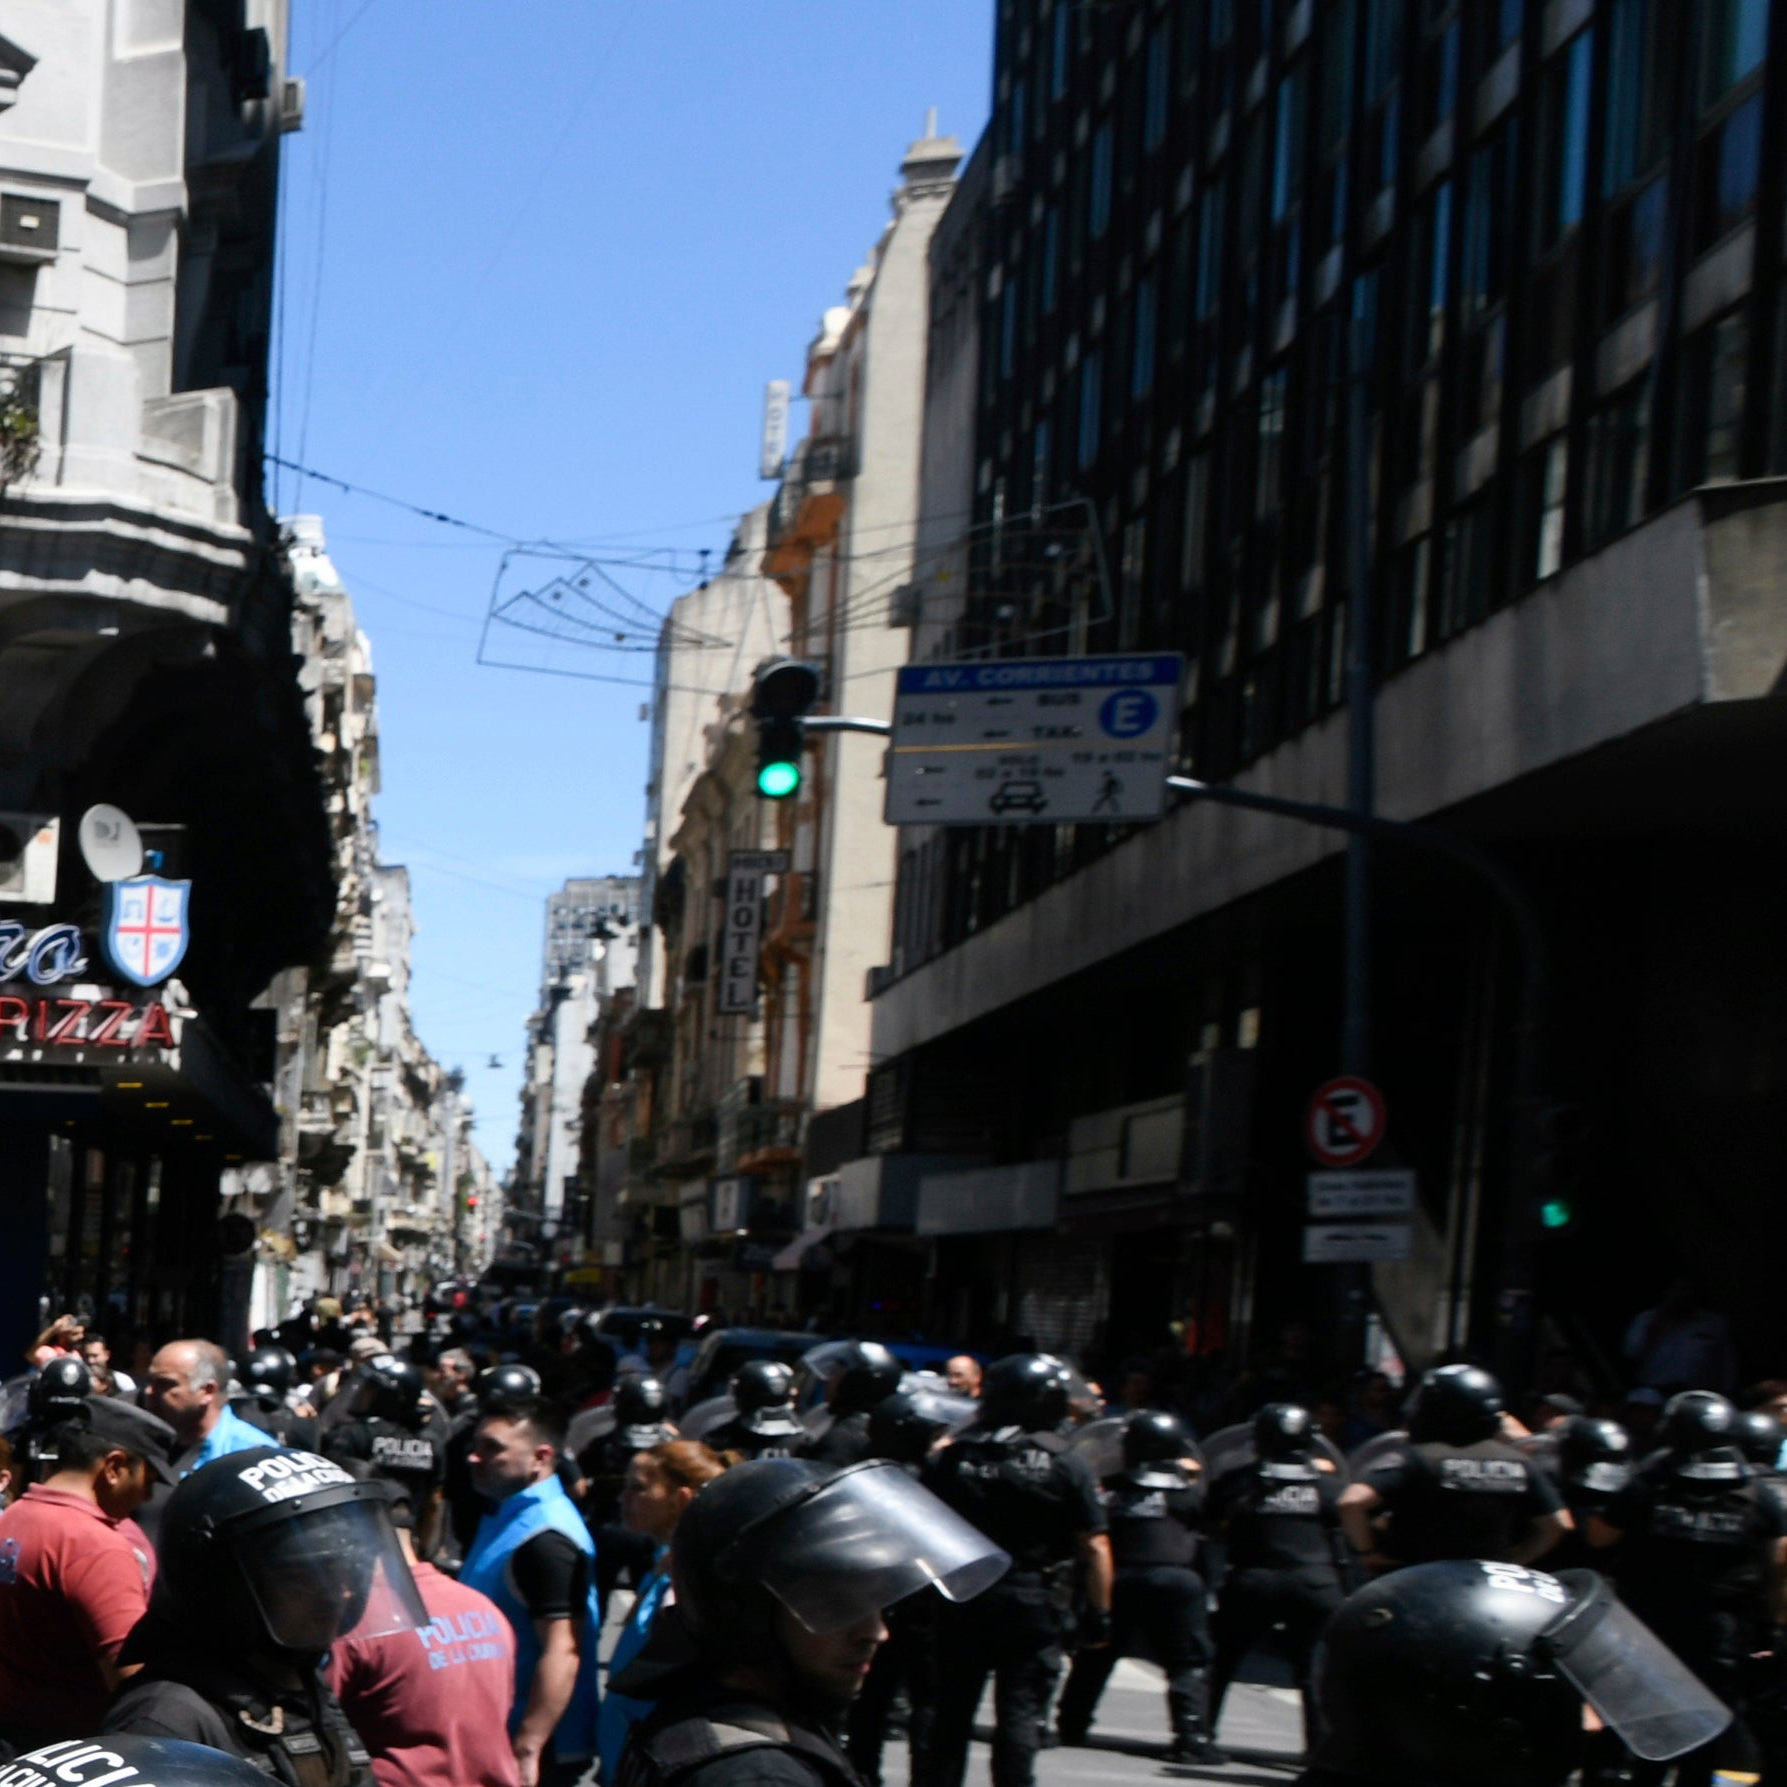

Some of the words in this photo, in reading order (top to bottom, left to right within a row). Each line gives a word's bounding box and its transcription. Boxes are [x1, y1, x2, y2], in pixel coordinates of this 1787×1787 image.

[922, 668, 967, 688] AV.
[976, 662, 1154, 686] CORRIENTES
[727, 879, 756, 1007] HOTEL
[371, 1436, 434, 1458] POLICIA
[415, 1610, 501, 1650] POLICIA
[427, 1650, 451, 1671] DE
